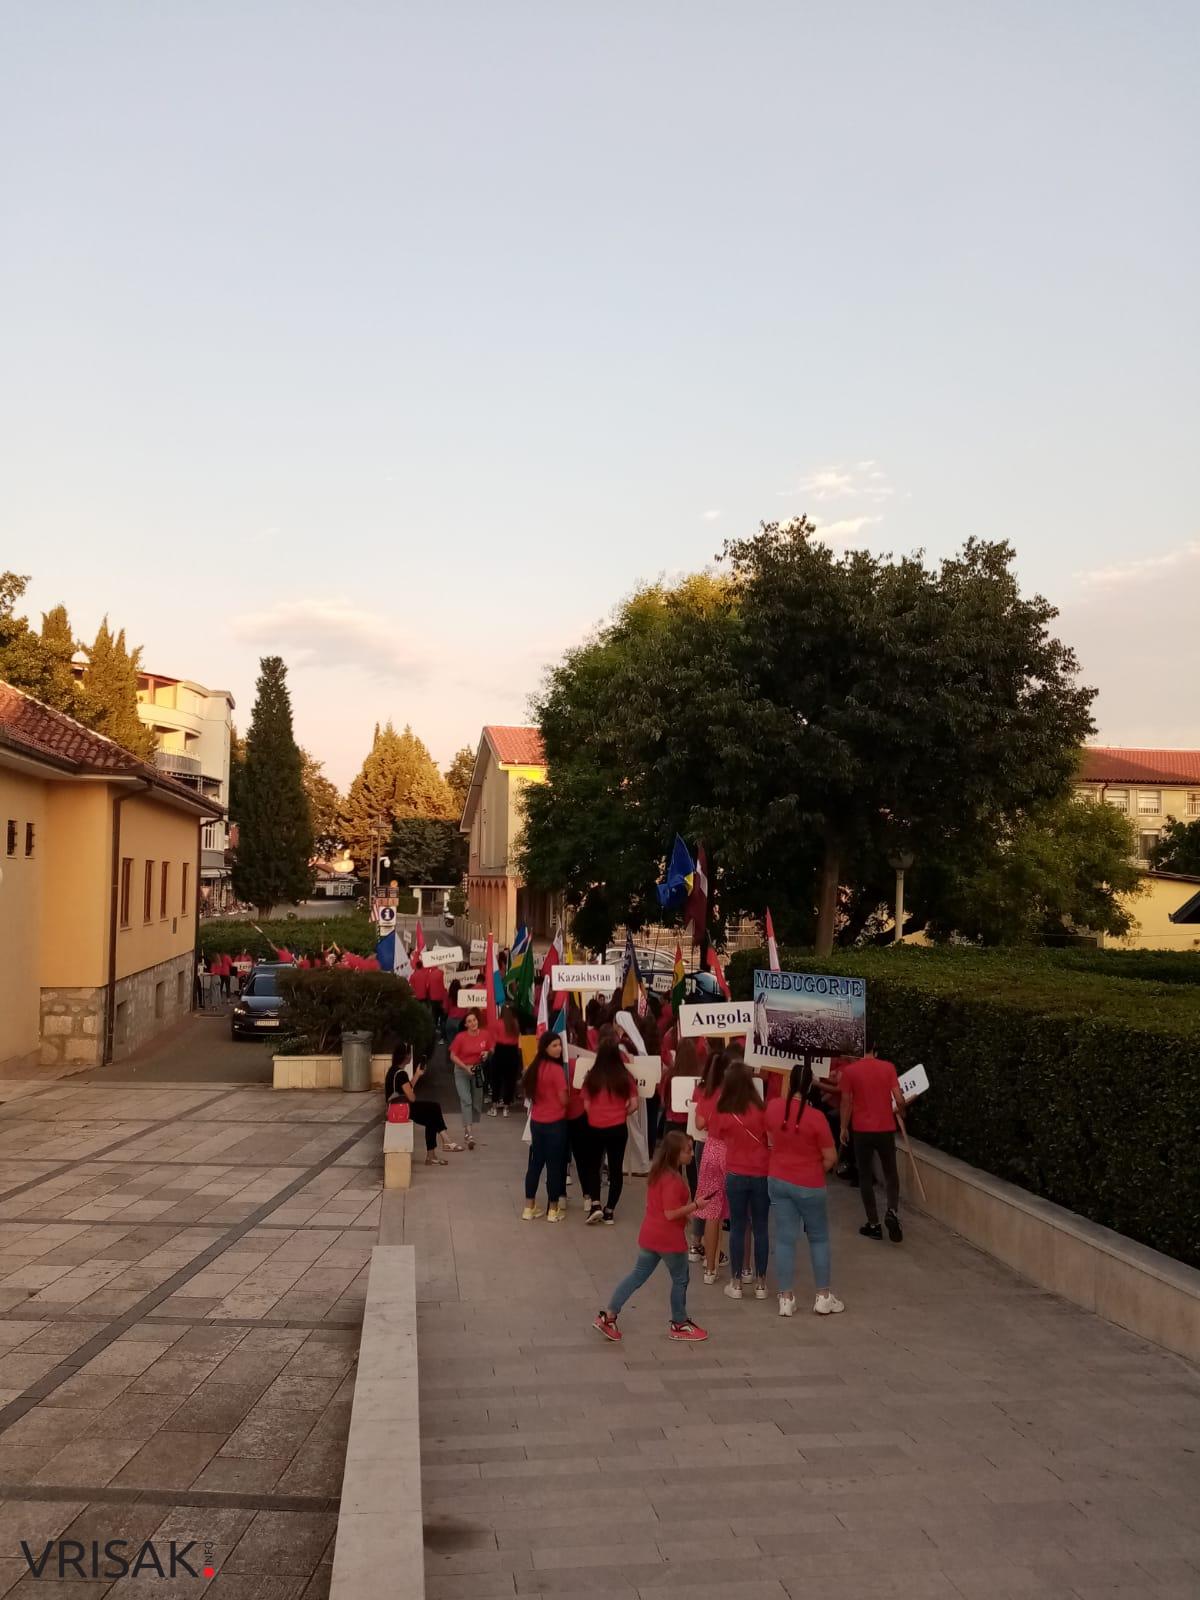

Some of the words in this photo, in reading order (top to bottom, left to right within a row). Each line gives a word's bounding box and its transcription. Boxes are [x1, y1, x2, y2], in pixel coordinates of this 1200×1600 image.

[430, 953, 455, 961] Nigeria
[557, 971, 611, 983] Kazakhstan
[691, 1010, 752, 1029] Angola
[753, 1044, 824, 1065] Indoneia
